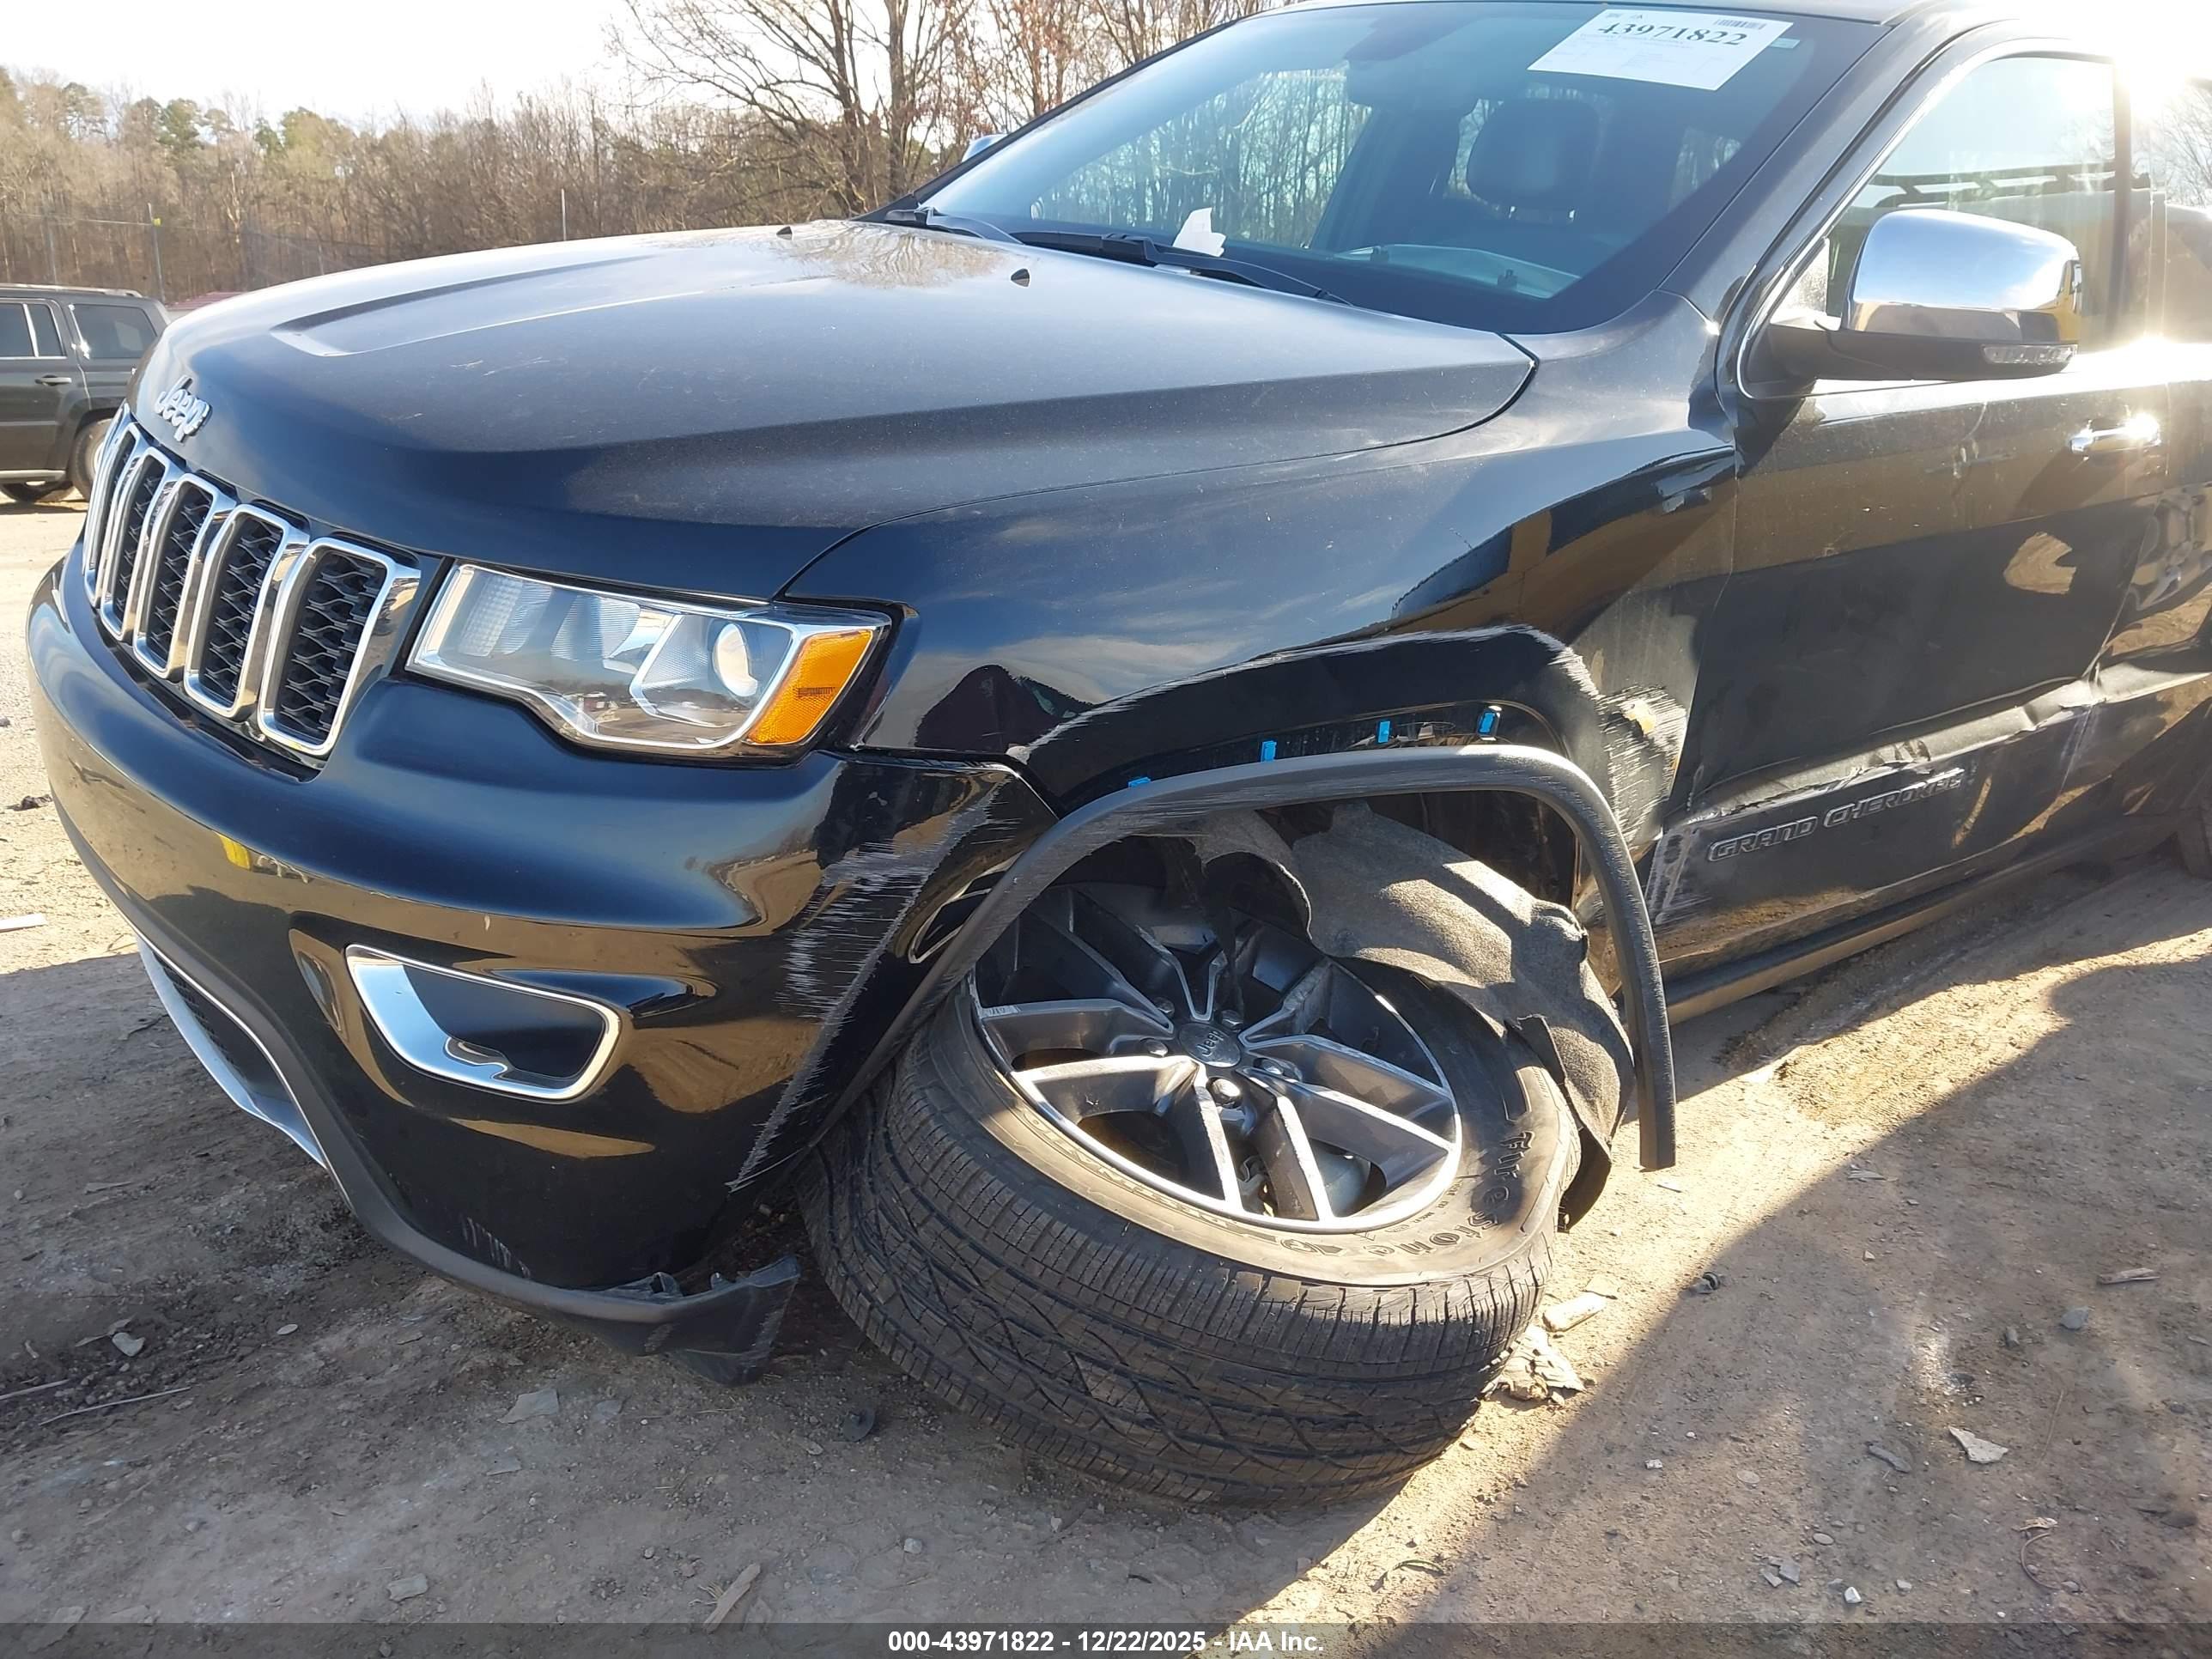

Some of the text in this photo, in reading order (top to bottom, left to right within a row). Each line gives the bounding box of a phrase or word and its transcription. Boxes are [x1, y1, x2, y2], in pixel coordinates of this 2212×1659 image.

[1597, 21, 1747, 46] 43971822
[155, 375, 212, 442] Jeep
[1709, 769, 1965, 862] GRAND CHEROKEE
[1196, 1030, 1224, 1057] Jeep
